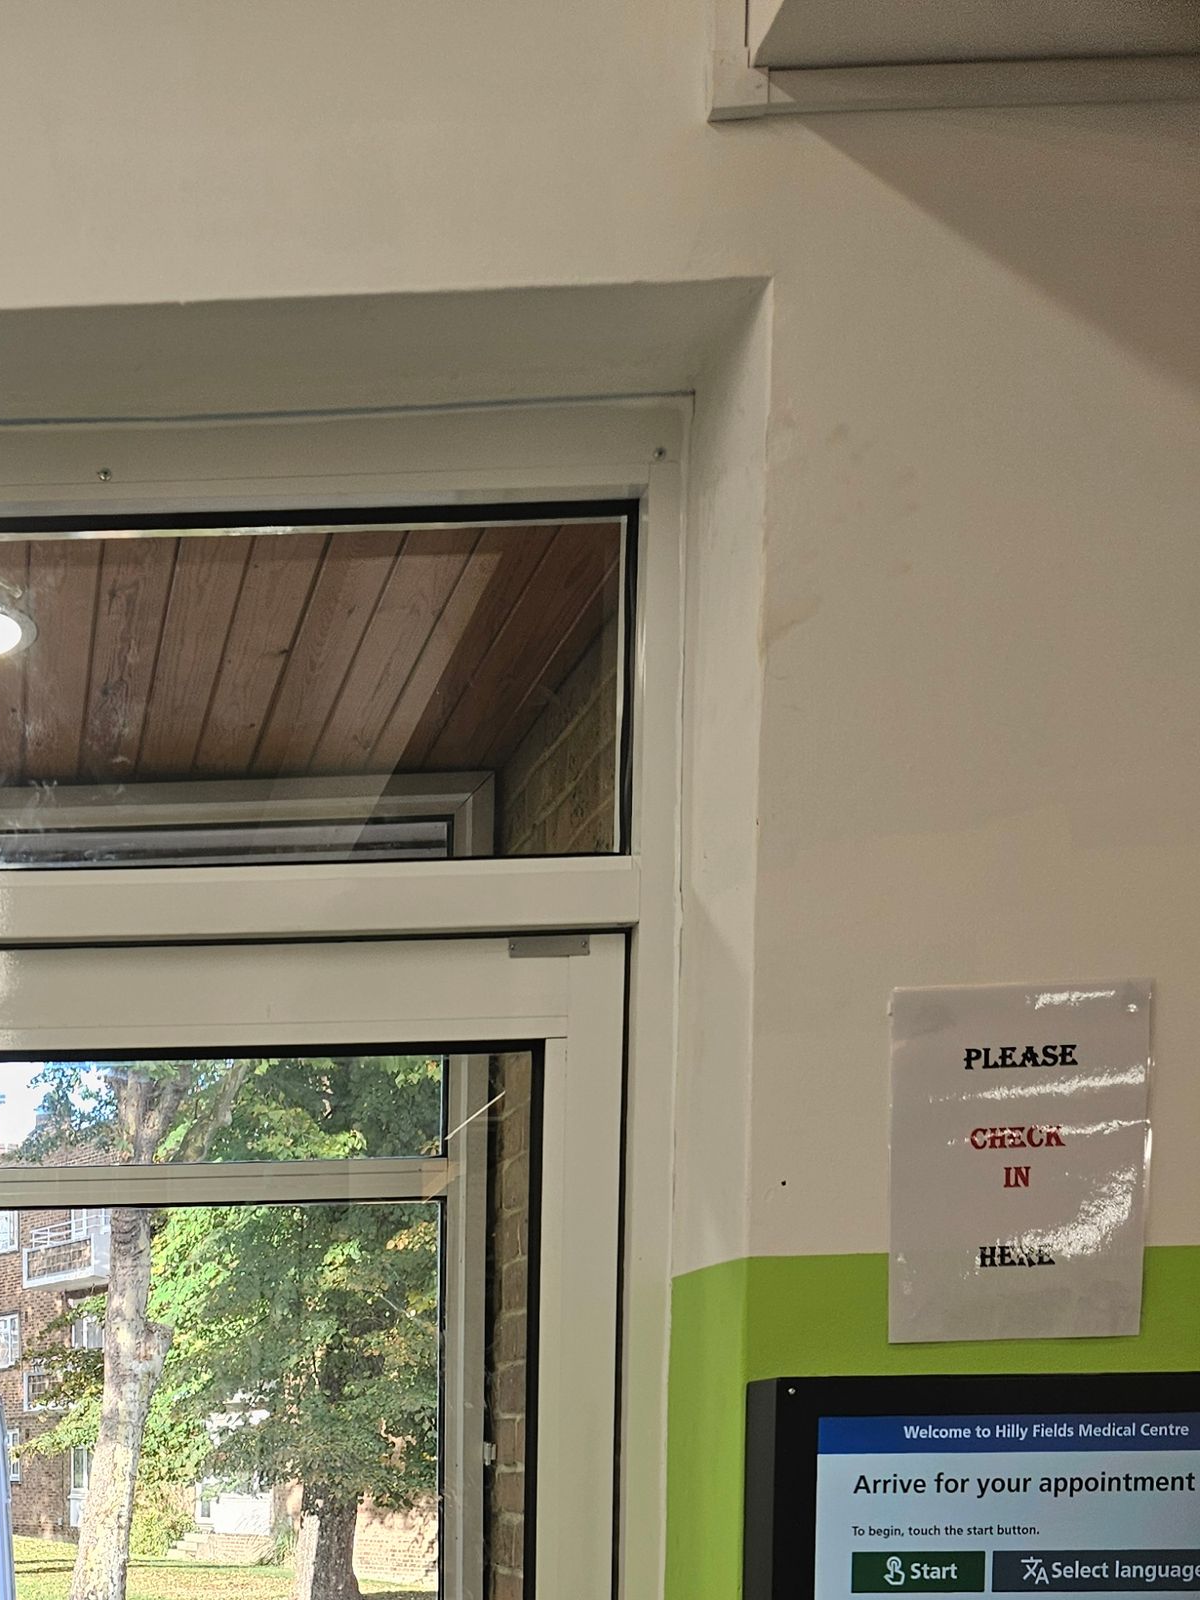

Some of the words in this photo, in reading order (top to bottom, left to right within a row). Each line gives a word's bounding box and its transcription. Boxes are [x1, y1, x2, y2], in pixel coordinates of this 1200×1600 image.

[963, 1044, 1078, 1070] PLEASE
[970, 1126, 1066, 1150] CHECK
[1003, 1166, 1031, 1188] IN
[903, 1425, 971, 1439] Welcome
[975, 1426, 991, 1438] to
[995, 1424, 1028, 1441] Hilly
[1032, 1423, 1074, 1438] Fields
[1078, 1422, 1136, 1437] Medical
[1140, 1423, 1190, 1437] Centre
[853, 1473, 926, 1494] Arrive
[934, 1472, 969, 1493] for
[977, 1475, 1032, 1498] your
[1039, 1472, 1195, 1497] appointment
[852, 1526, 865, 1537] To
[868, 1526, 905, 1539] begin,
[908, 1526, 941, 1537] touch
[944, 1525, 963, 1536] the
[967, 1525, 993, 1536] start
[997, 1525, 1040, 1536] button.
[910, 1563, 957, 1580] Start
[1051, 1561, 1108, 1579] Select
